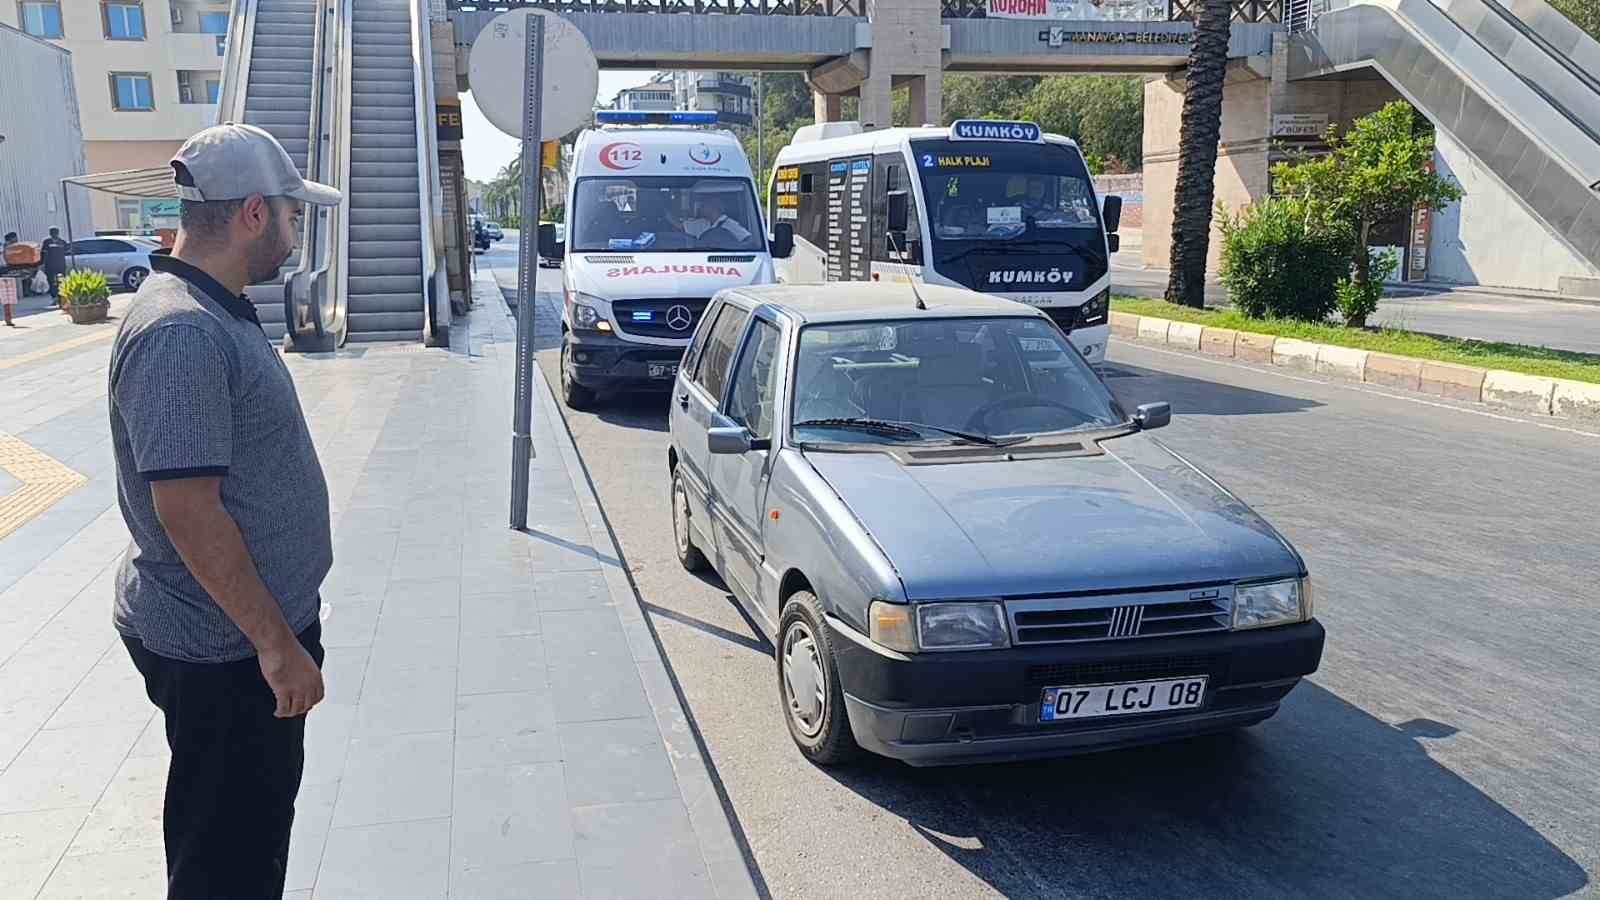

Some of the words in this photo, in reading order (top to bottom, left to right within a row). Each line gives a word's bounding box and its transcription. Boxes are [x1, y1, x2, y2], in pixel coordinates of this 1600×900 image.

[960, 124, 1034, 139] KUMKÖY
[611, 150, 642, 161] 112
[922, 154, 934, 167] 2
[938, 156, 962, 166] HALK
[988, 268, 1073, 283] KUMKÖY
[1055, 691, 1090, 714] 07
[1105, 685, 1155, 711] LCJ
[1168, 682, 1202, 705] 08
